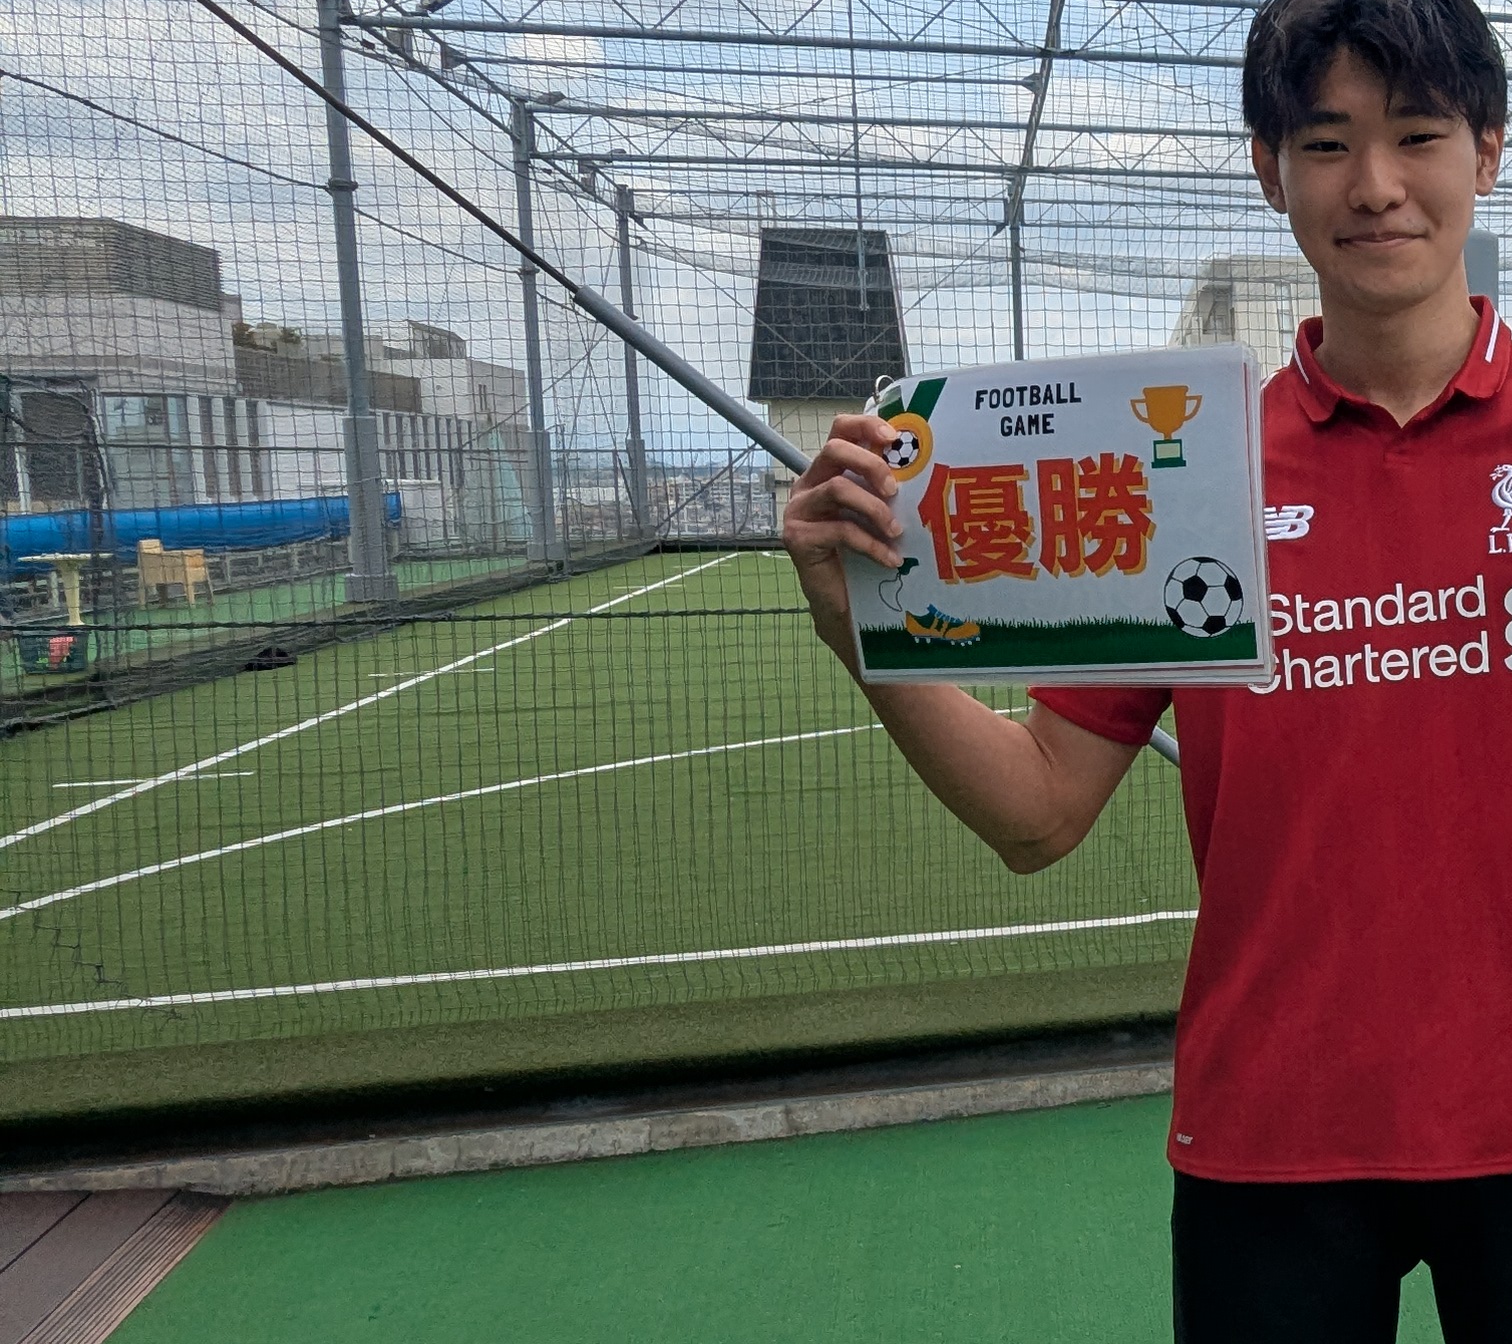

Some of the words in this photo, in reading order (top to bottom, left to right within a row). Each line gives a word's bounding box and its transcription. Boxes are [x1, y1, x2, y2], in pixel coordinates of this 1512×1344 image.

[975, 382, 1082, 410] FOOTBALL
[1000, 413, 1055, 437] GAME
[917, 452, 1156, 585] 優勝
[1269, 574, 1487, 637] Standard
